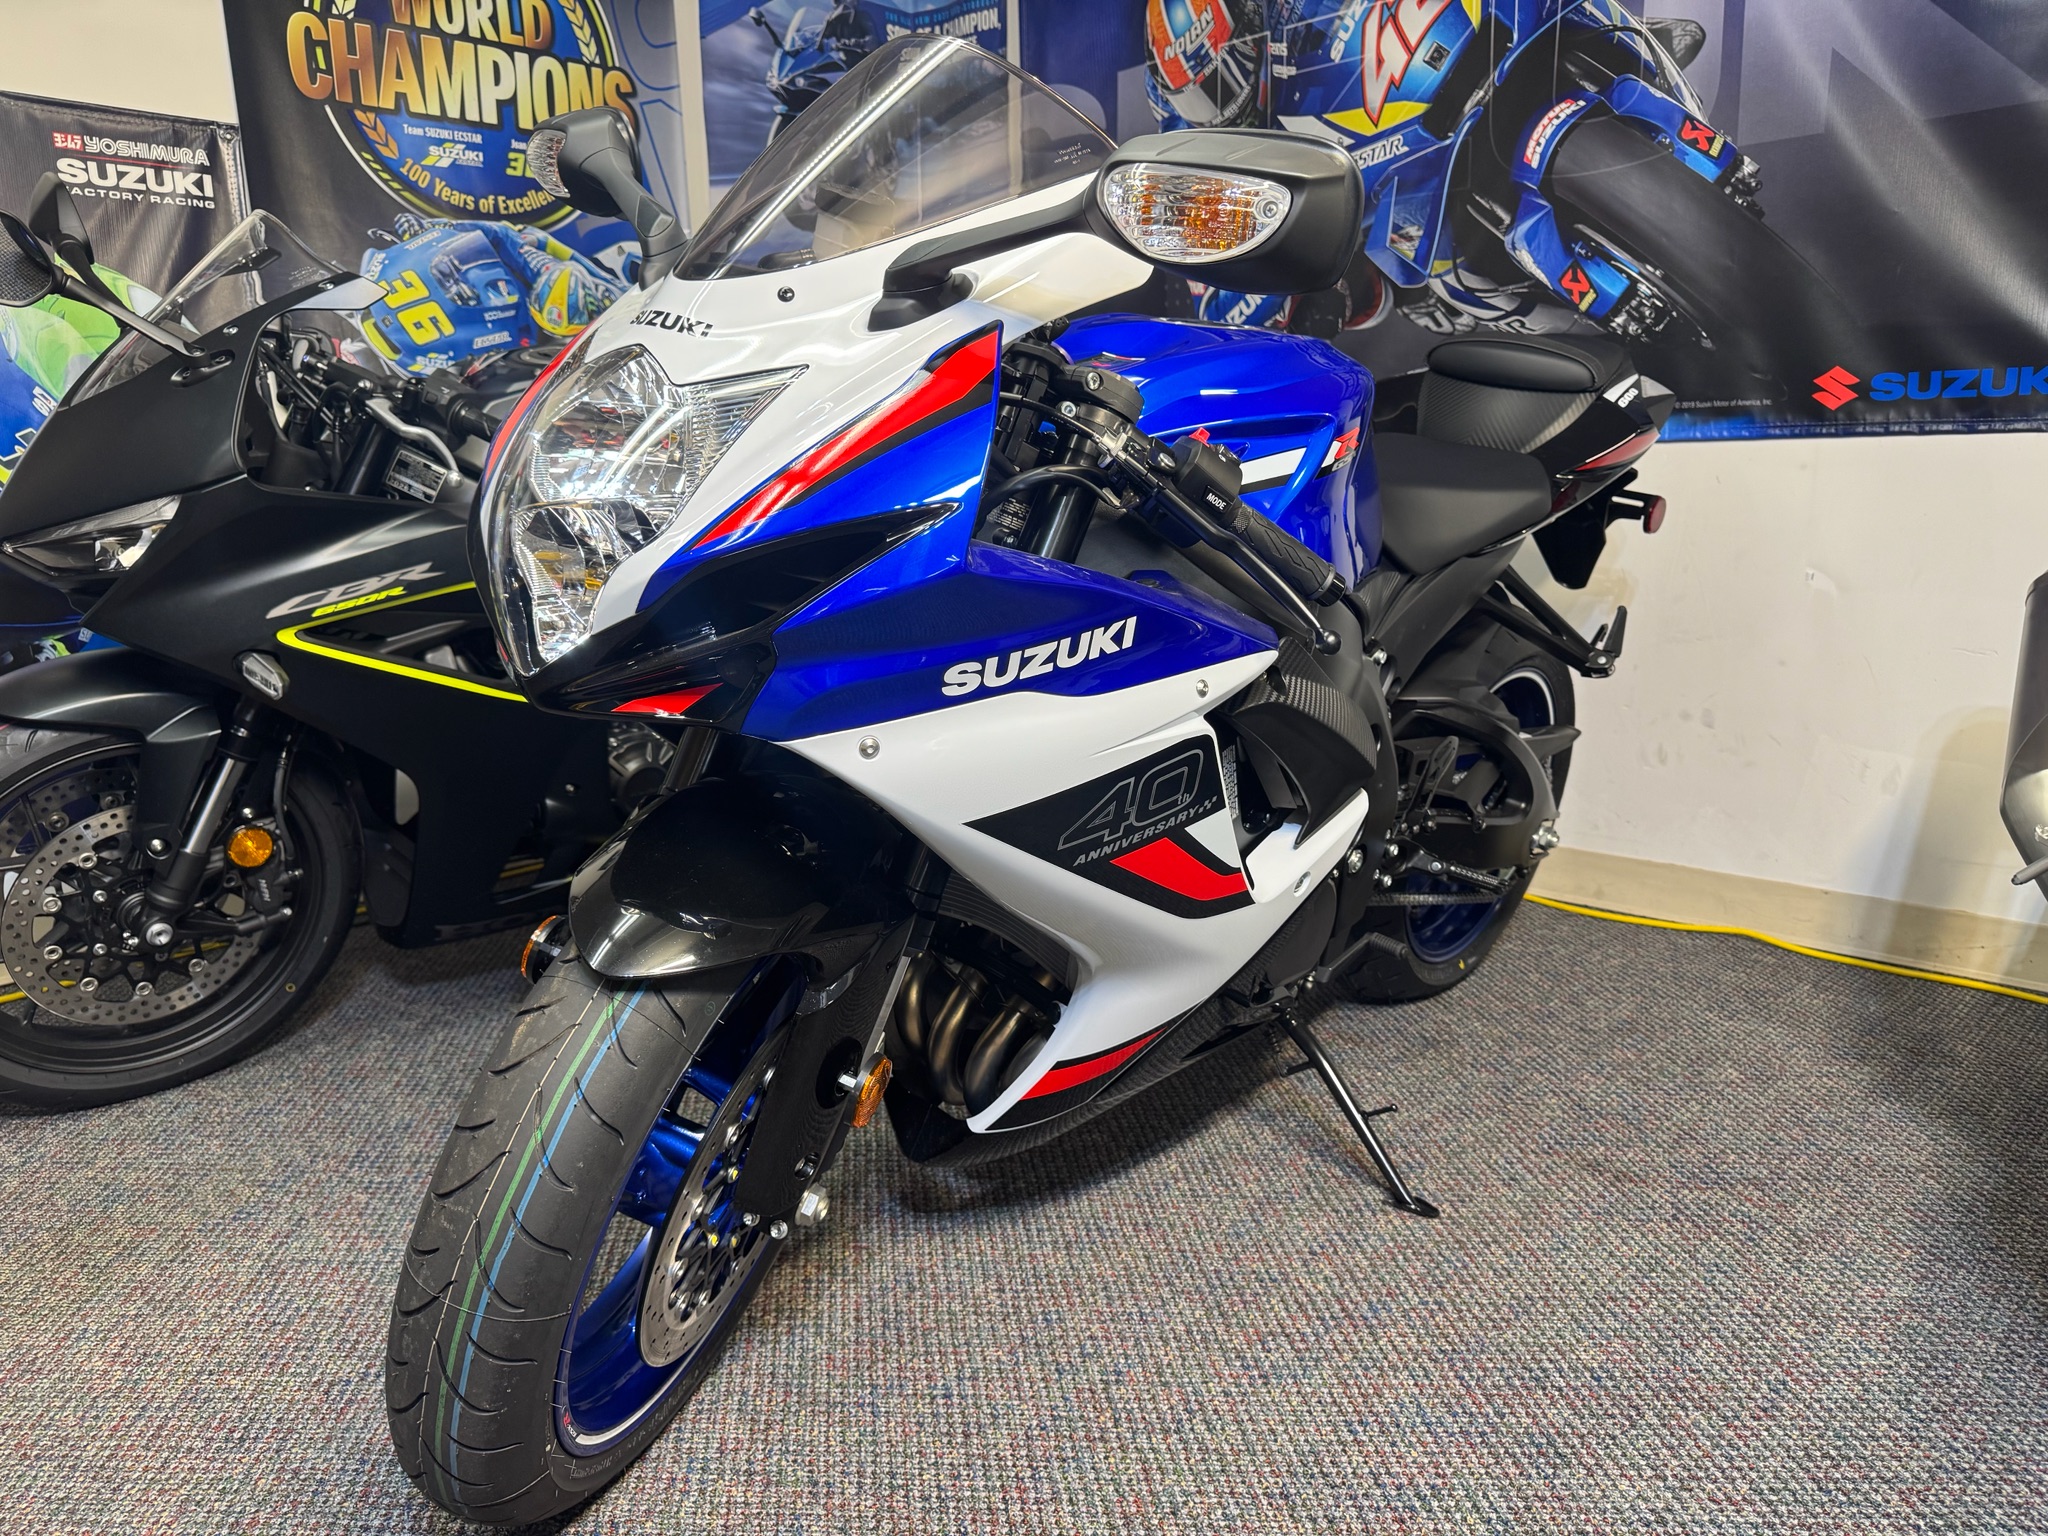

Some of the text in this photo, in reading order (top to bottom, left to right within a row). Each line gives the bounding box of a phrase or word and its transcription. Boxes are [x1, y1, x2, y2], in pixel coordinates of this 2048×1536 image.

[1164, 3, 1214, 61] NOLAN
[1330, 0, 1368, 63] SUZ
[286, 11, 638, 137] CHAMPIONS
[403, 124, 482, 144] Team SUZUKI ECSTAR
[1523, 98, 1576, 165] MOTUL
[1530, 99, 1587, 170] SUZUKI
[84, 135, 210, 166] YOSHIMURA
[428, 144, 484, 162] SUZUKI
[1351, 134, 1410, 171] STAR
[56, 158, 214, 198] SUZUKI
[400, 158, 430, 188] 100
[434, 177, 475, 211] Years
[479, 198, 495, 214] of
[66, 186, 216, 209] ACTORY RACING
[630, 309, 713, 338] SUZUKI
[1617, 387, 1639, 408] 600
[1869, 366, 2048, 401] SUZUK
[1696, 400, 1713, 408] Suzuki
[1730, 399, 1737, 407] of
[1737, 398, 1762, 407] America,
[1206, 492, 1227, 510] MODE
[265, 561, 446, 619] CBR
[311, 586, 407, 618] 650R
[941, 615, 1137, 697] SUZUKI
[1073, 805, 1200, 867] ANNIVERSARY
